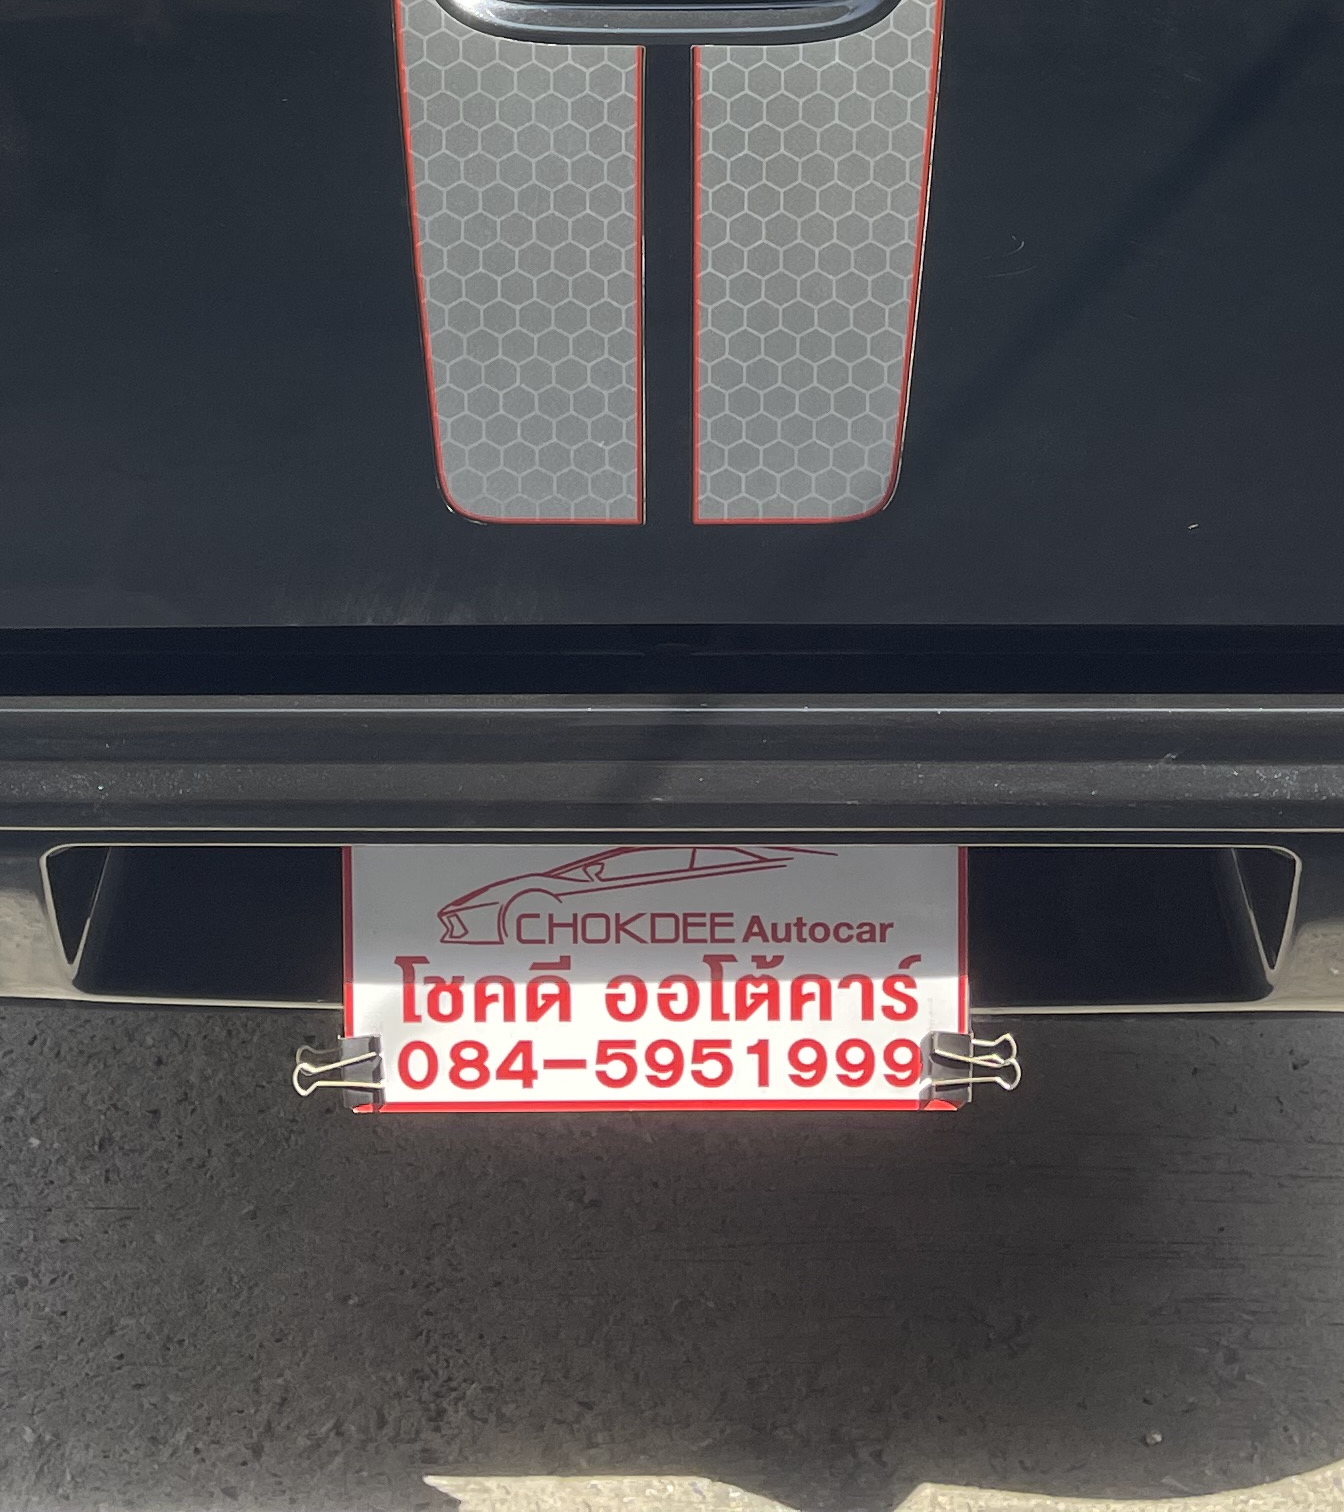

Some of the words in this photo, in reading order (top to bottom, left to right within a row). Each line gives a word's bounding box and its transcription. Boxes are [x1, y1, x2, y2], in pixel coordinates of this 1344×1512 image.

[514, 911, 735, 946] CHOKDEE
[742, 914, 895, 945] Autocar
[394, 955, 573, 1025] โชคดี
[604, 953, 923, 1025] ออโต้คาร์
[397, 1038, 923, 1091] 084-5951999
